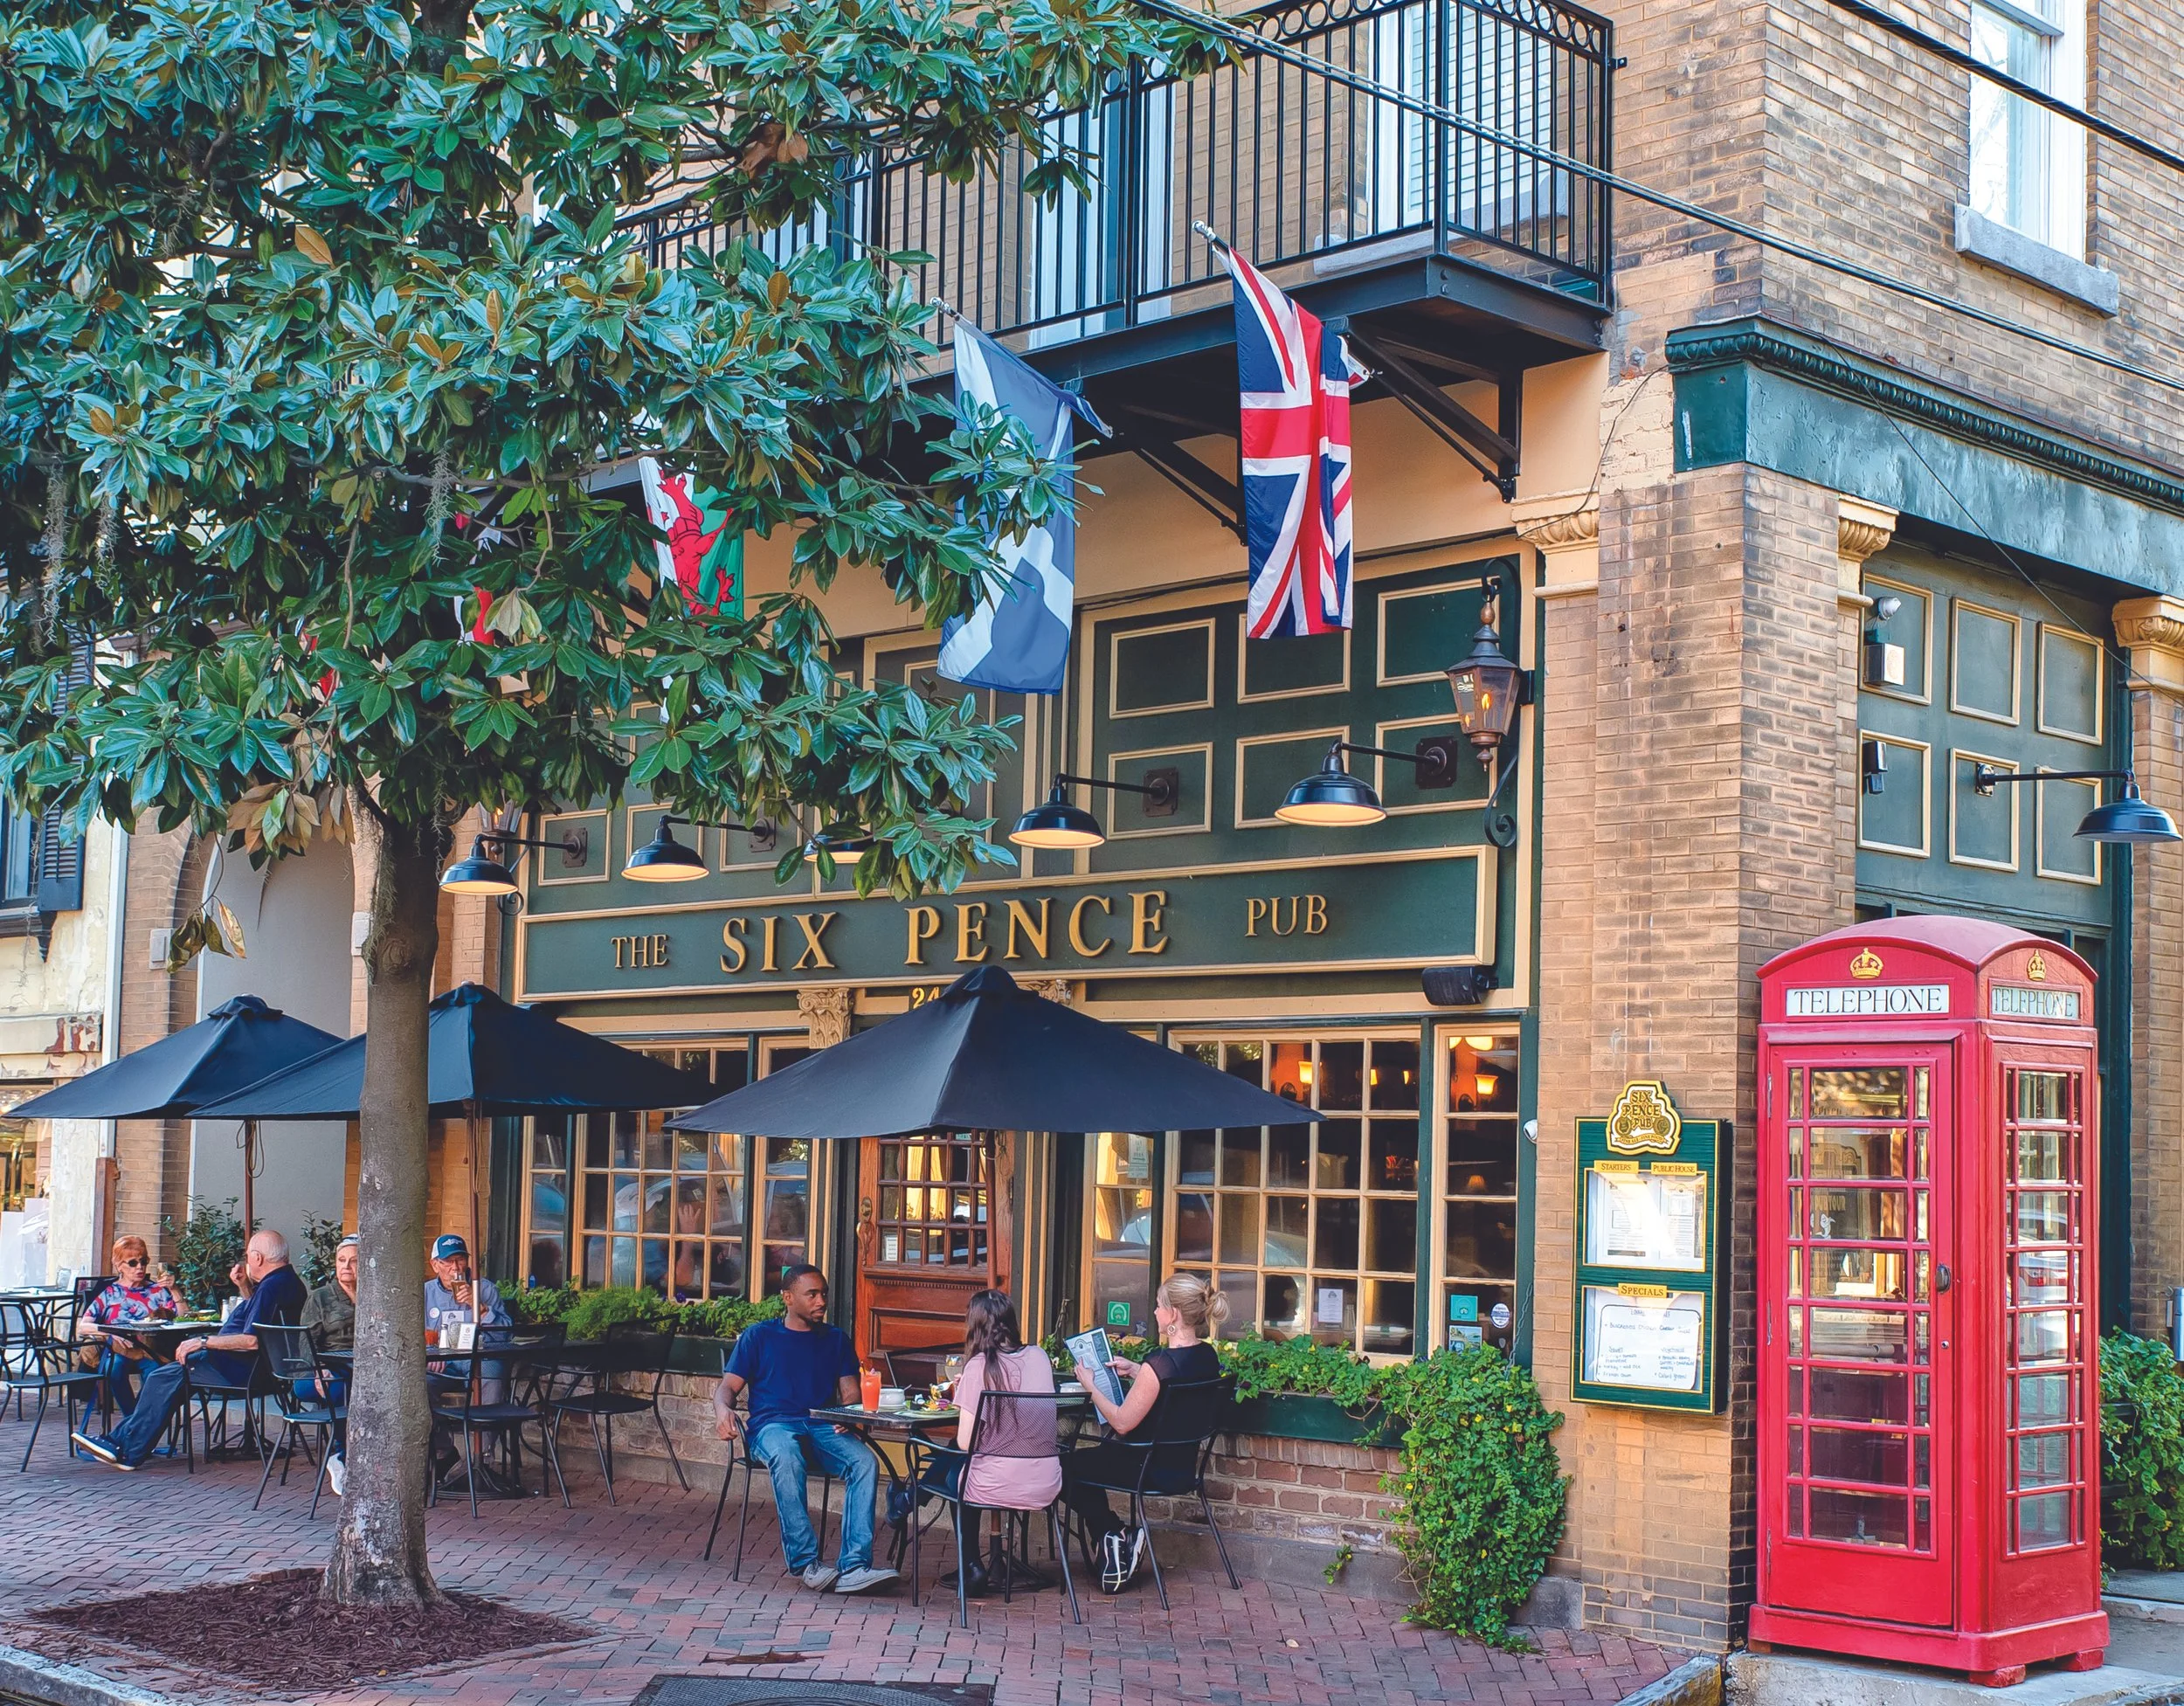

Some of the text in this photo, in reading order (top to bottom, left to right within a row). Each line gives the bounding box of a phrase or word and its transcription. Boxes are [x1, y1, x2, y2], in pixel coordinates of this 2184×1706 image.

[611, 889, 1329, 974] THE SIX PENCE PUB
[1794, 987, 1942, 1014] TELEPHONE
[1992, 987, 2073, 1017] TELEPHONE
[1631, 1090, 1653, 1103] SIX
[1622, 1104, 1661, 1116] PENCE
[1633, 1117, 1652, 1129] PUB
[1621, 1285, 1664, 1296] SPECIALS
